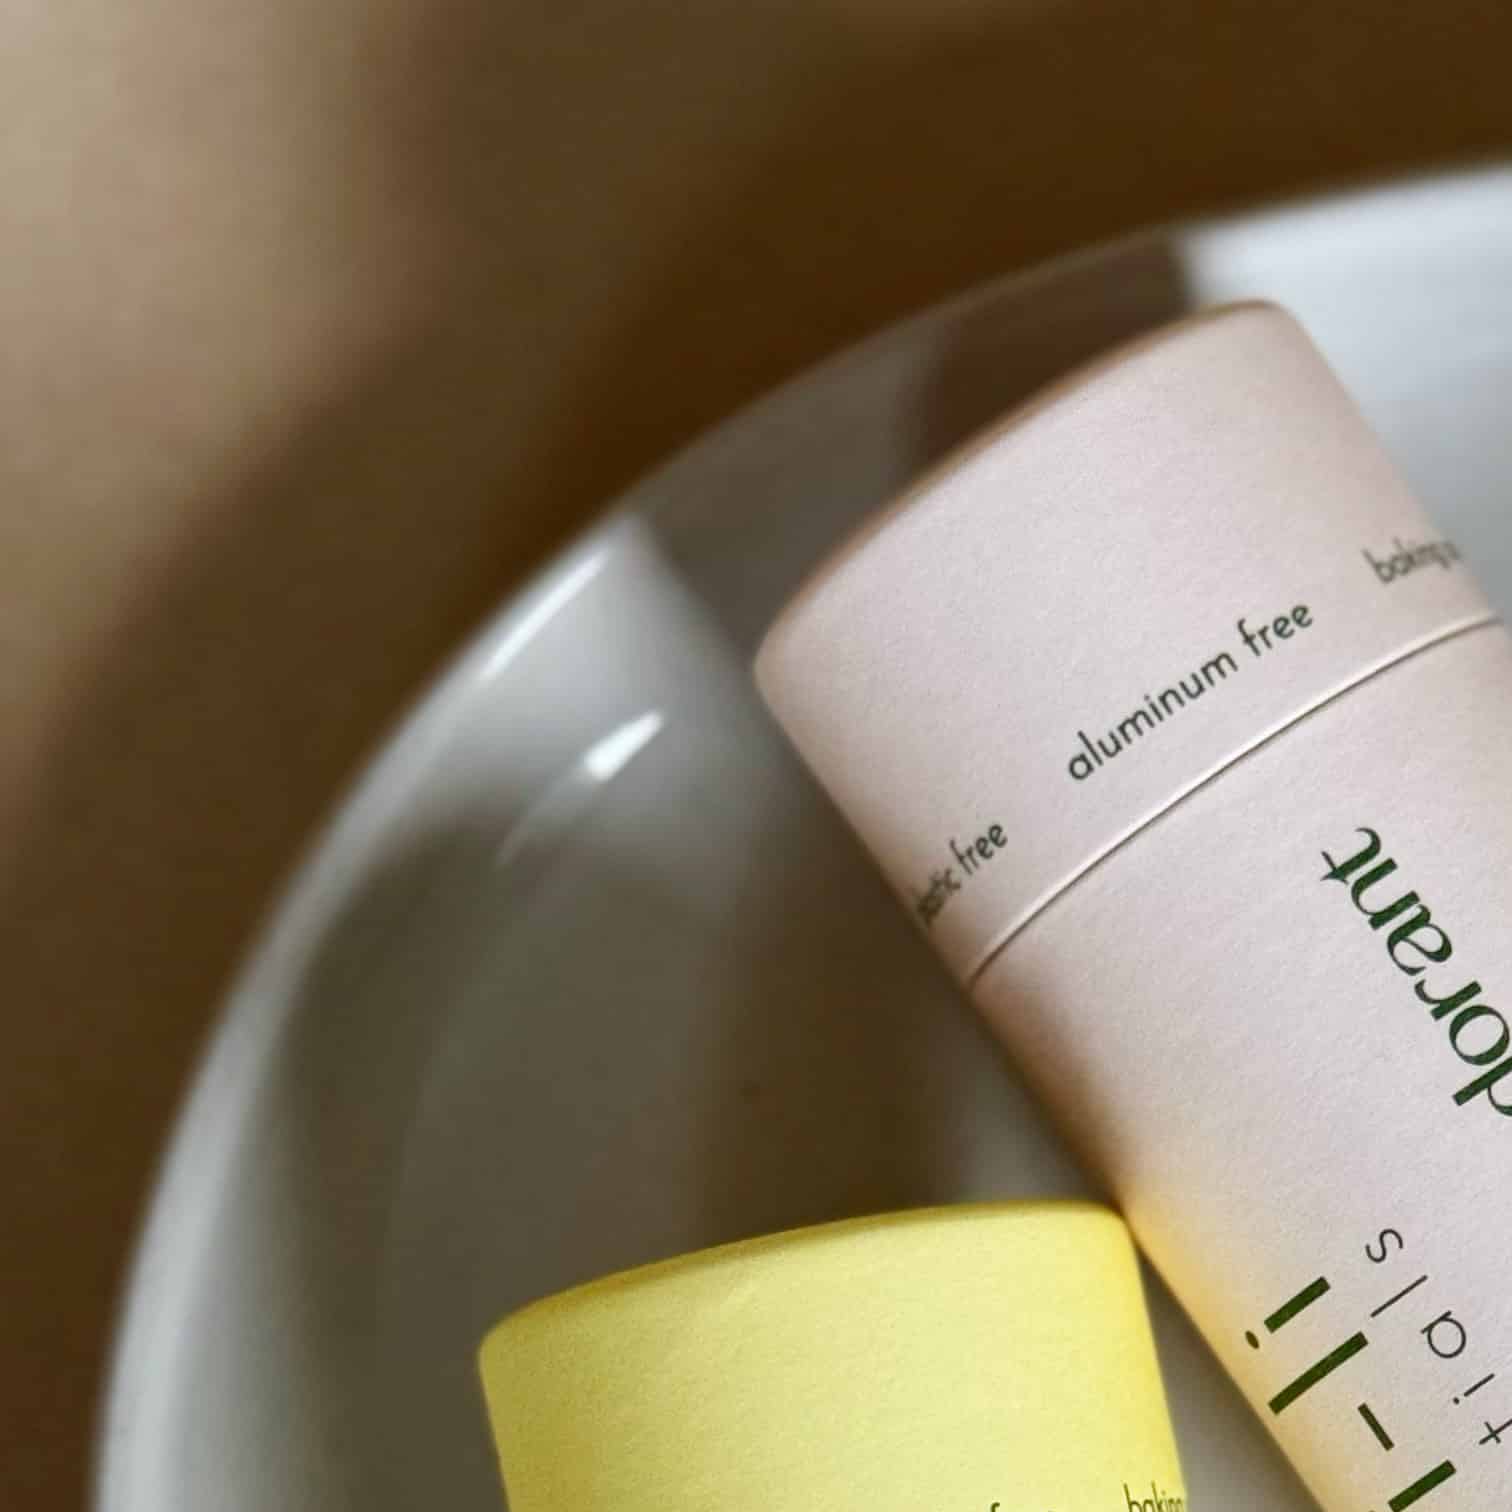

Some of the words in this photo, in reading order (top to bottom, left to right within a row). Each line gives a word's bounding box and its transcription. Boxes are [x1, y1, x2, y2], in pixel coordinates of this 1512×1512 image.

[949, 823, 1008, 876] free
[1067, 649, 1239, 782] aluminum
[1237, 603, 1315, 657] free
